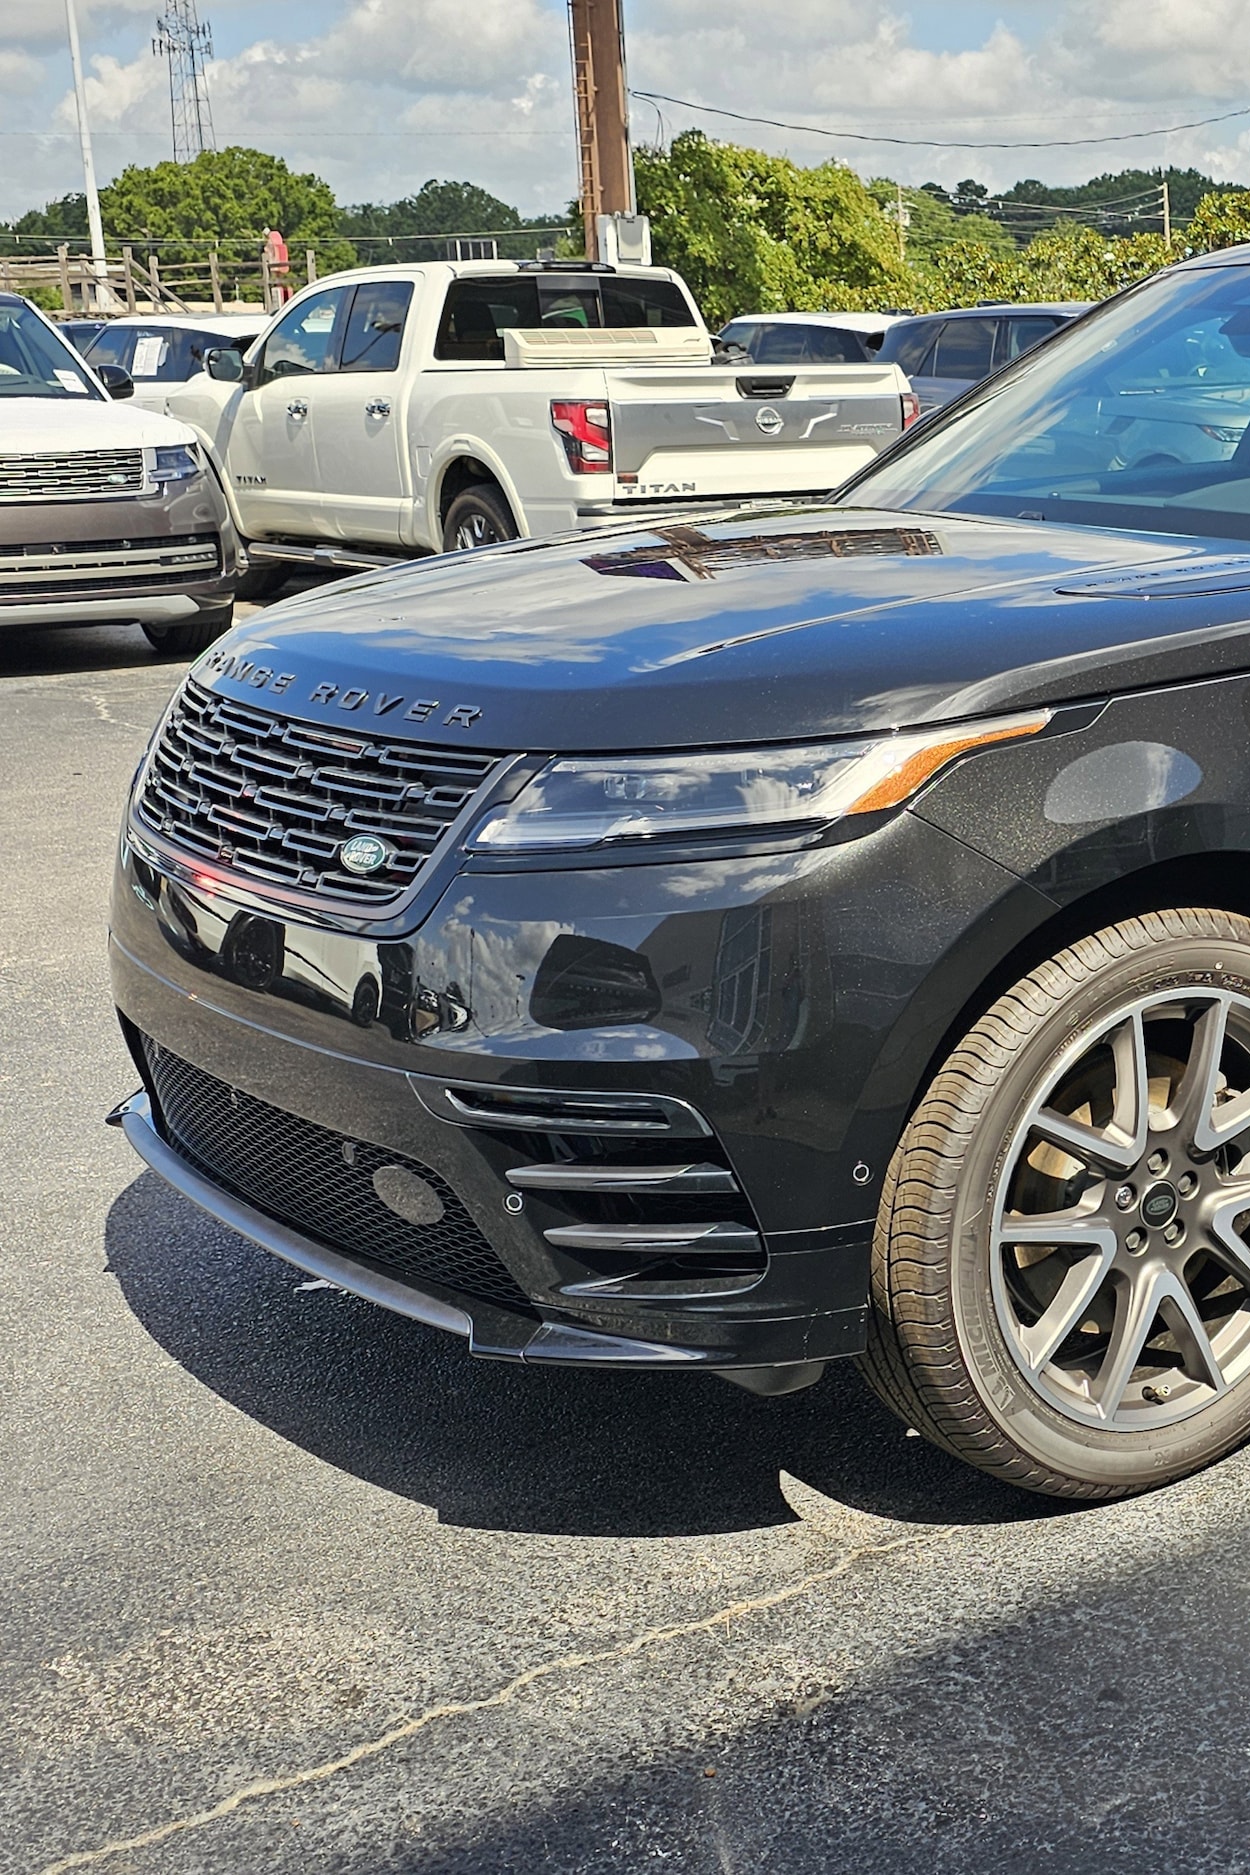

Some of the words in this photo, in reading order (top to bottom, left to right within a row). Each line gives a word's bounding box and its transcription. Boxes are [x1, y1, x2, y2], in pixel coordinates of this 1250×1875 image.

[235, 475, 267, 485] TITAN
[622, 482, 696, 495] TITAN
[204, 650, 297, 695] RANGE
[309, 681, 484, 728] ROVER
[350, 840, 374, 853] LAND
[348, 850, 377, 865] ROVER
[960, 1233, 997, 1378] MICHELIN
